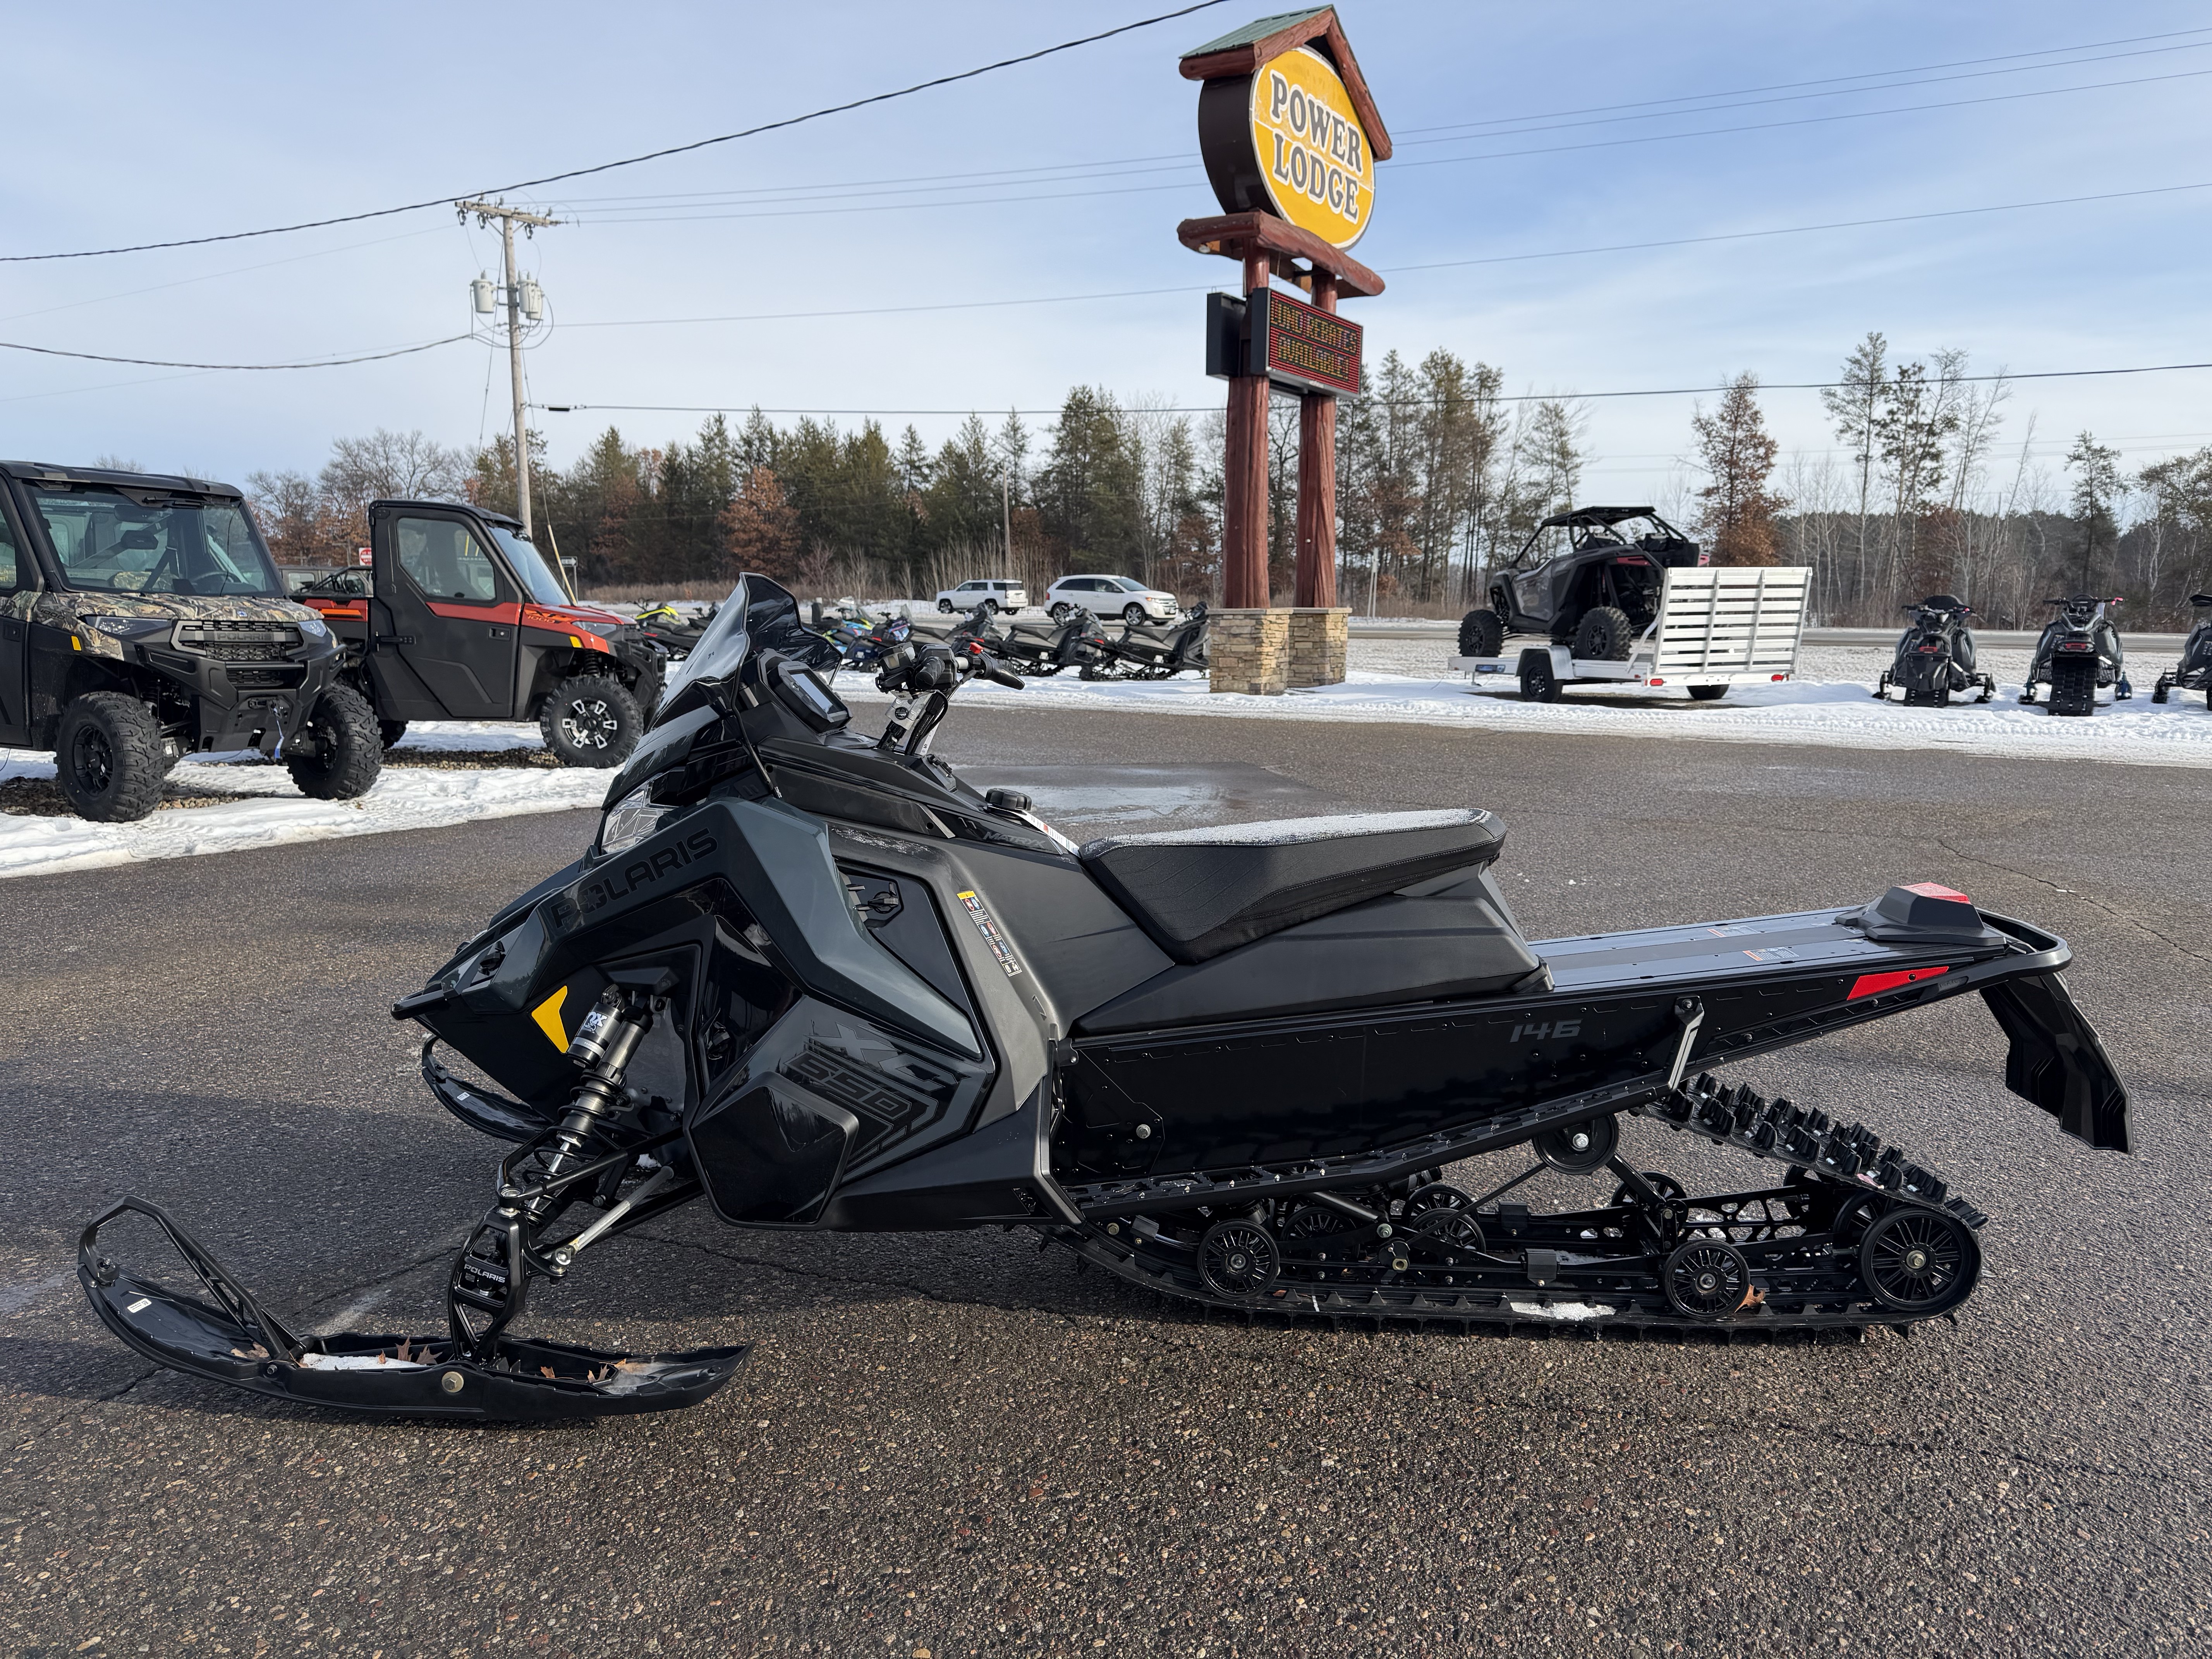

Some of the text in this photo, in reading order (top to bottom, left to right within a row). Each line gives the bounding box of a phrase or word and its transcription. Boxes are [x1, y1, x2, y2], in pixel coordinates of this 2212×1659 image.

[1272, 73, 1362, 173] POWER
[1274, 133, 1358, 220] LODGE
[1306, 314, 1357, 353] REBATES
[40, 609, 65, 620] 1000
[527, 615, 555, 623] 1000
[983, 831, 1046, 849] MATRYX
[550, 827, 718, 929] POLARIS
[1510, 1018, 1583, 1042] 146
[803, 1022, 958, 1091] XC
[785, 1050, 911, 1119] 650
[464, 1263, 506, 1283] POLARIS
